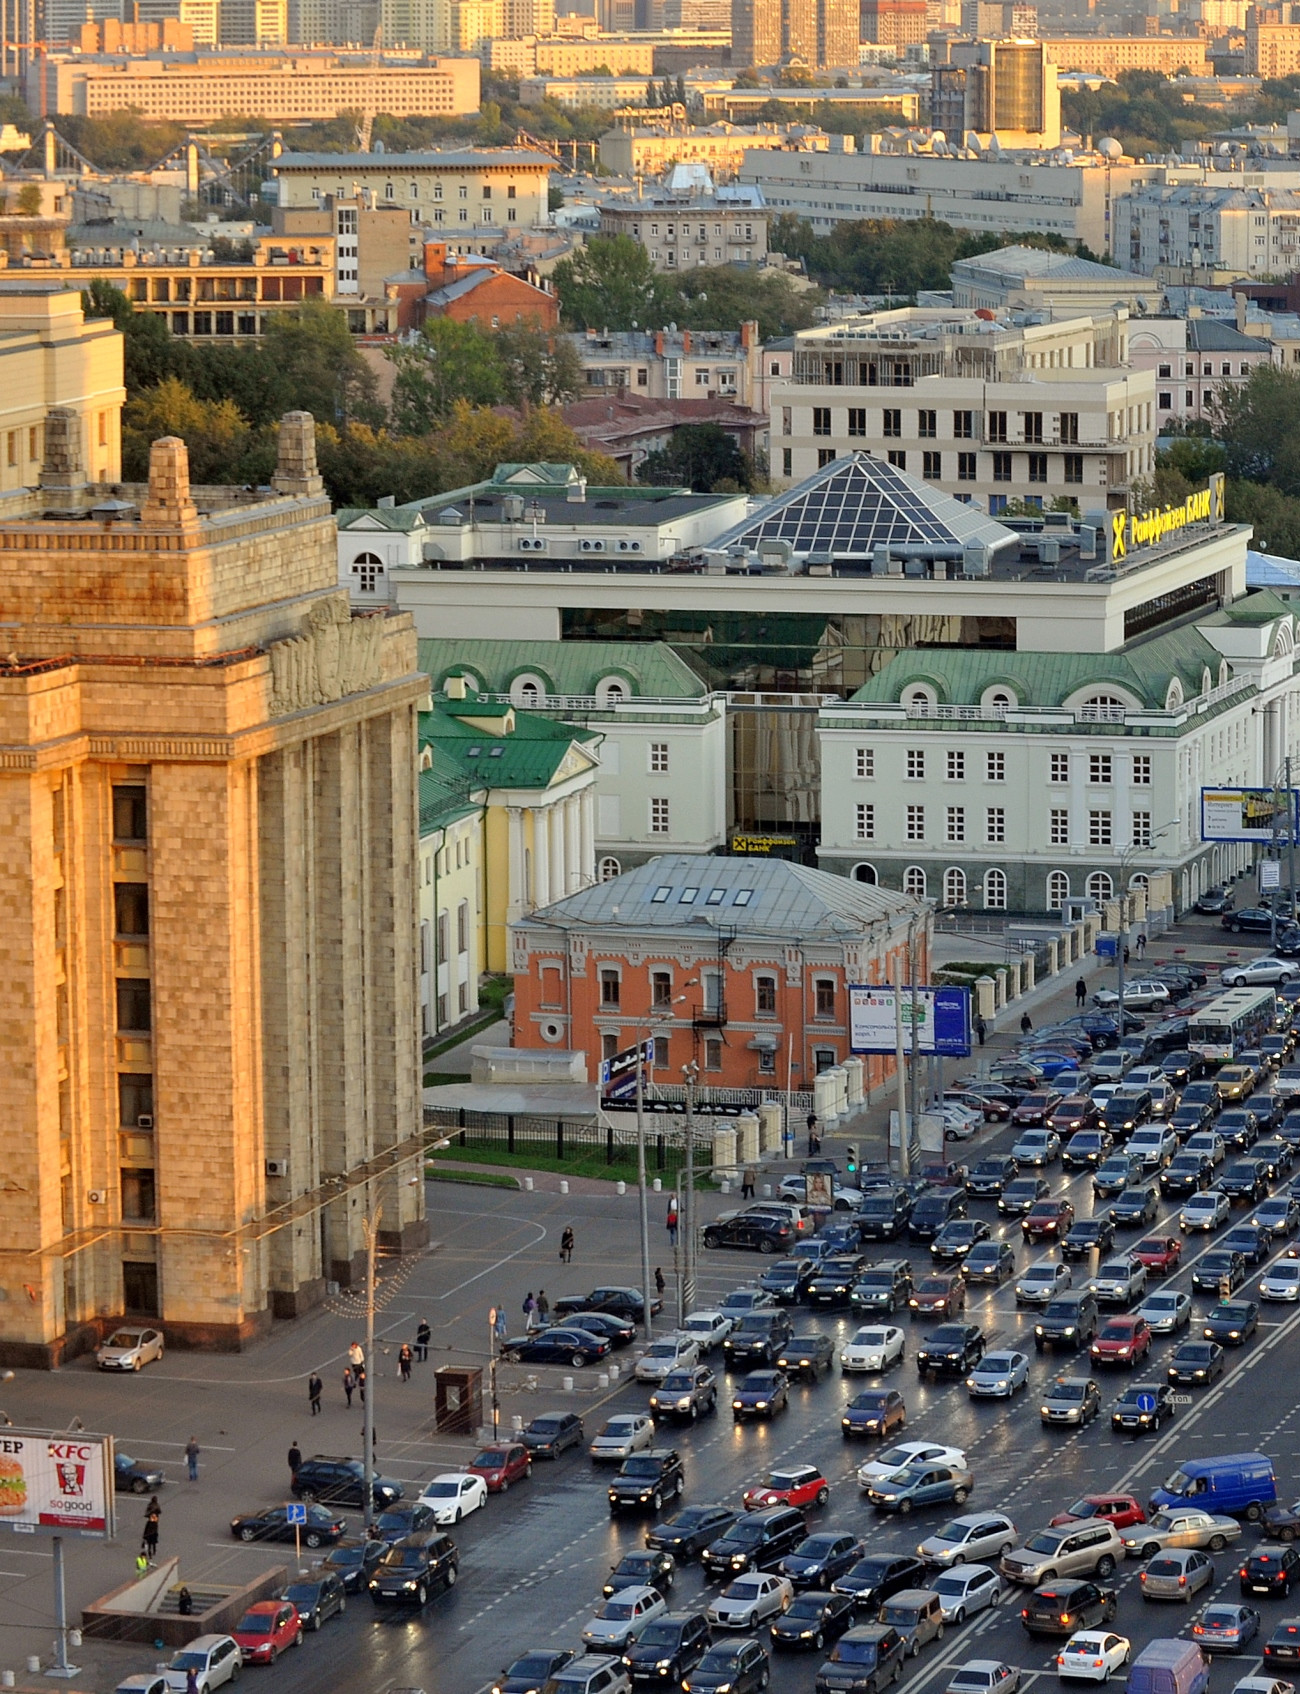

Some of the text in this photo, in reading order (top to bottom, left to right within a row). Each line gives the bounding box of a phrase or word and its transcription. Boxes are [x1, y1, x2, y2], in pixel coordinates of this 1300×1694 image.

[1131, 489, 1211, 545] Райффайзен БАНК
[48, 1444, 91, 1460] KFC
